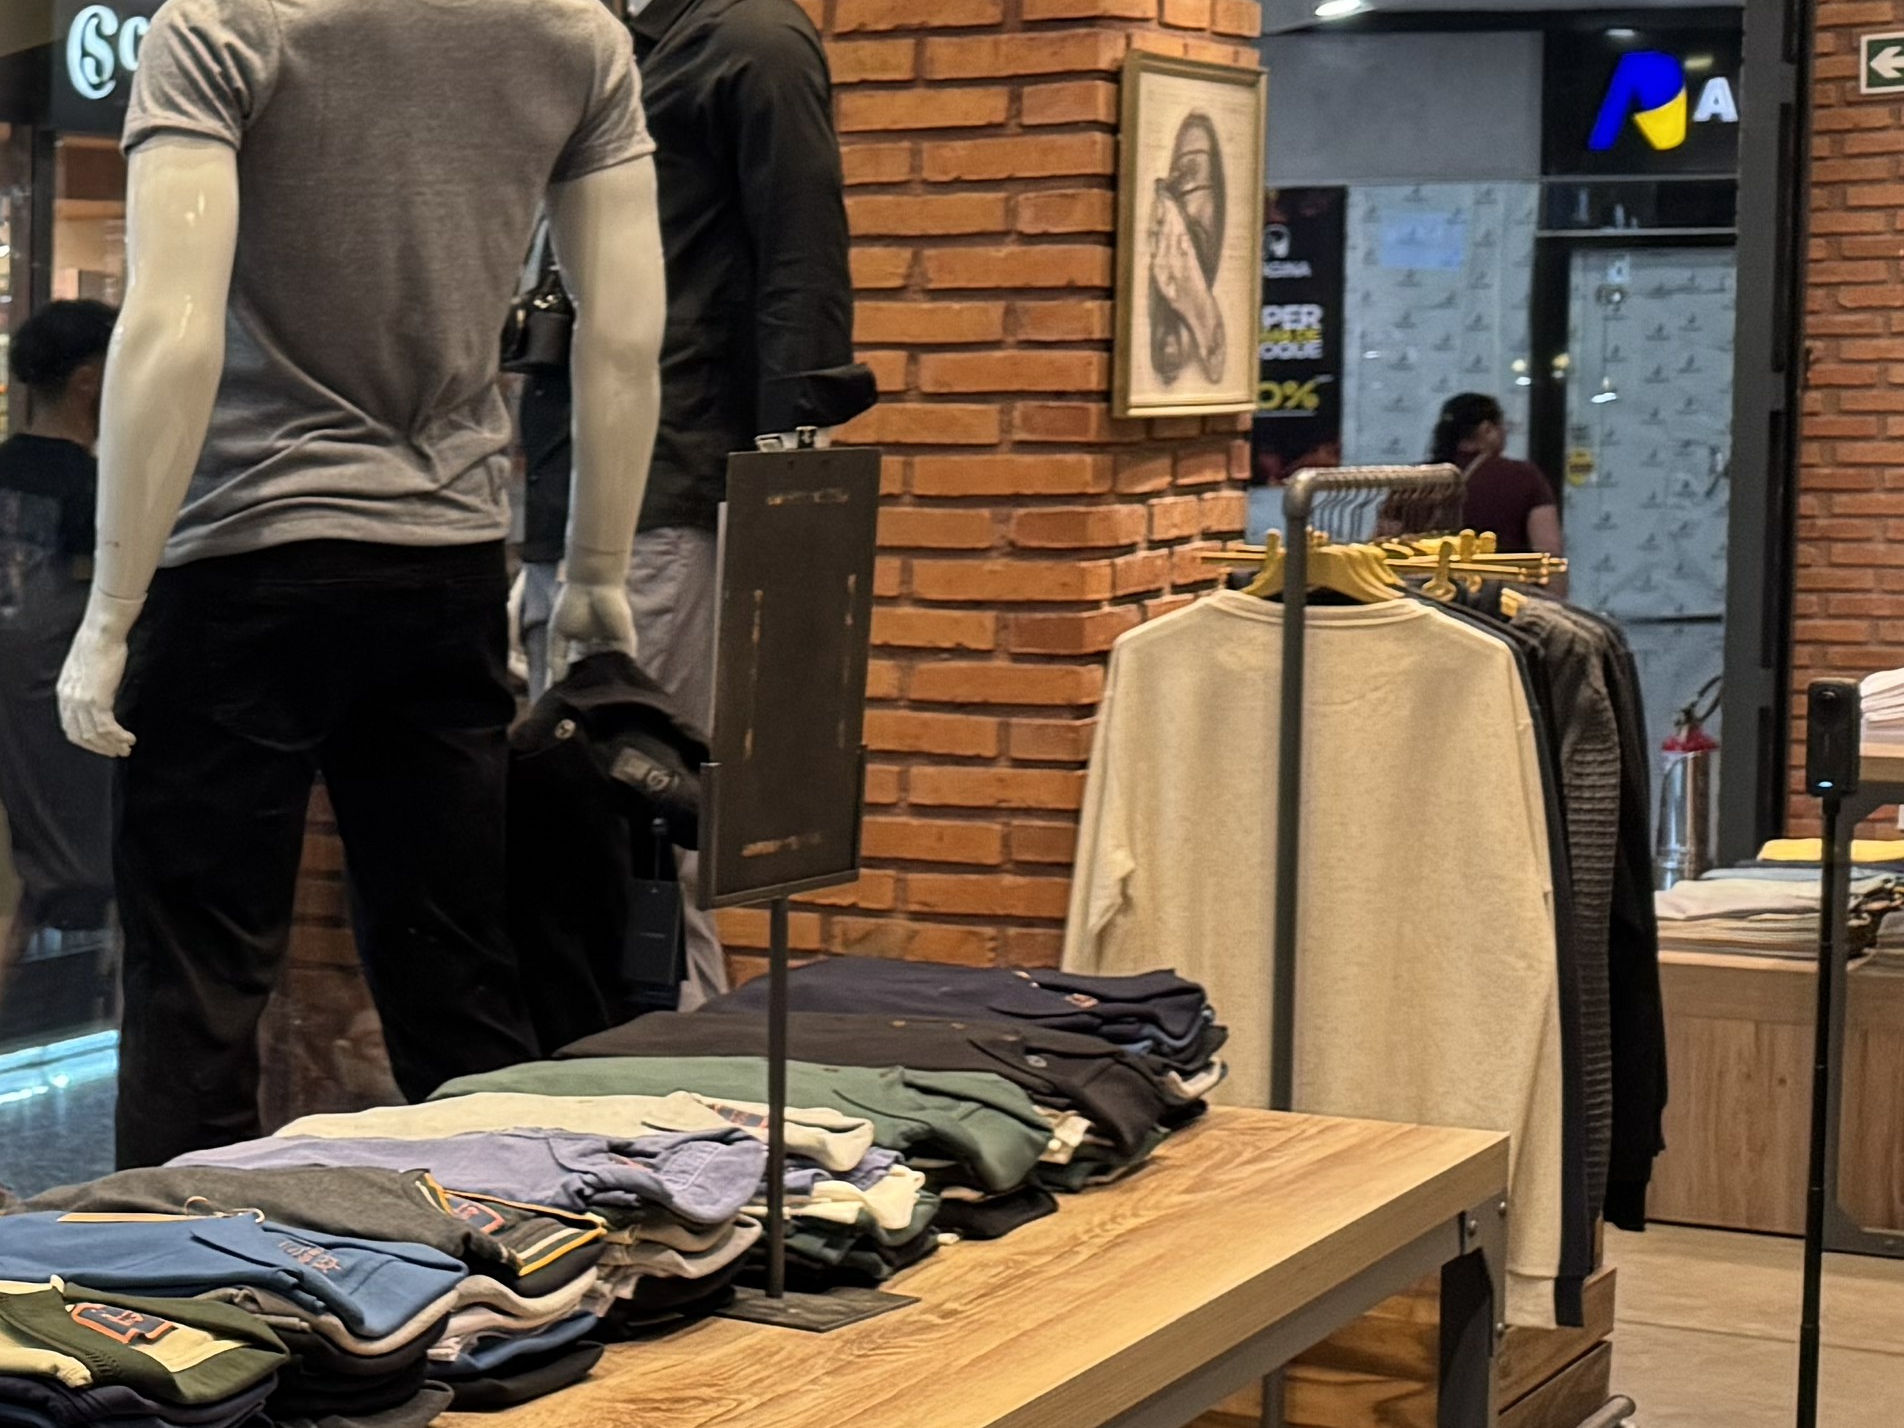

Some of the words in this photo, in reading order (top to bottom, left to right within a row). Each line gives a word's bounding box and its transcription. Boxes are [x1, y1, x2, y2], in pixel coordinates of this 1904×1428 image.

[1262, 304, 1324, 330] PER
[1260, 343, 1323, 360] OQUE
[1258, 380, 1321, 410] 0%
